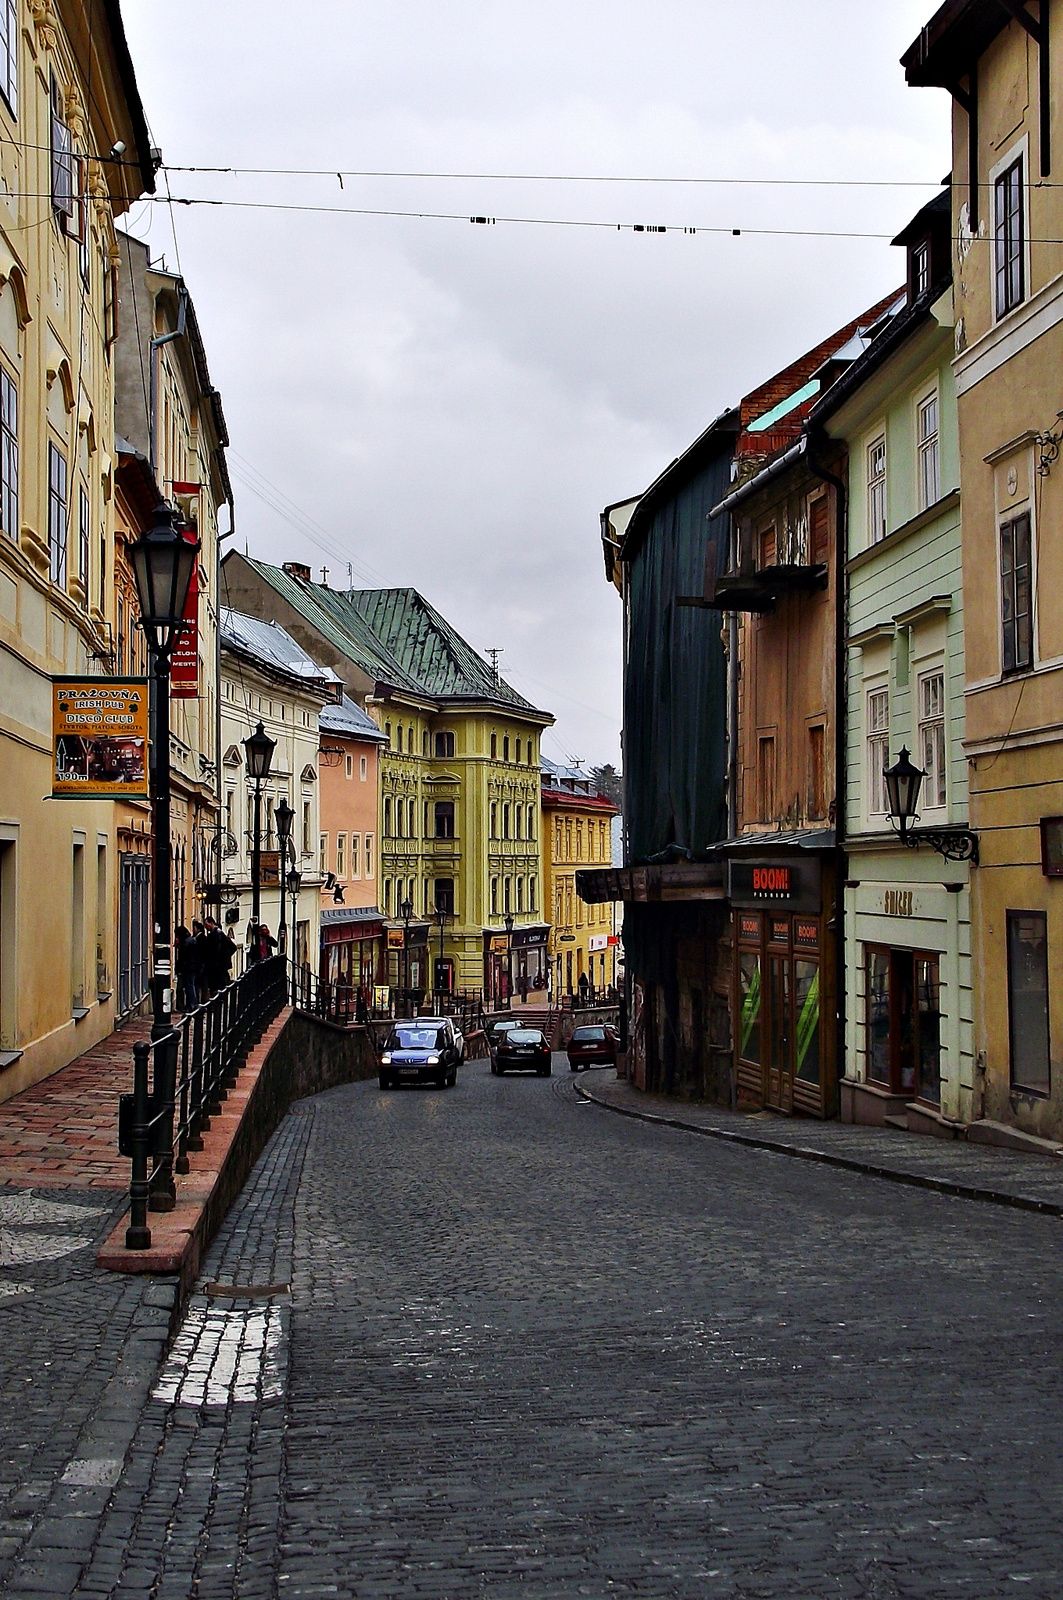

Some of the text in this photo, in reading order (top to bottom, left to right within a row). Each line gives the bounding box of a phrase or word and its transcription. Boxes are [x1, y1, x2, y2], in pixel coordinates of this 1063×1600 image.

[75, 700, 125, 709] IRISH PUB
[66, 714, 134, 723] DISCO CLUB
[59, 772, 89, 781] 190m
[753, 868, 789, 890] BOOM!
[798, 925, 817, 938] BOOM!
